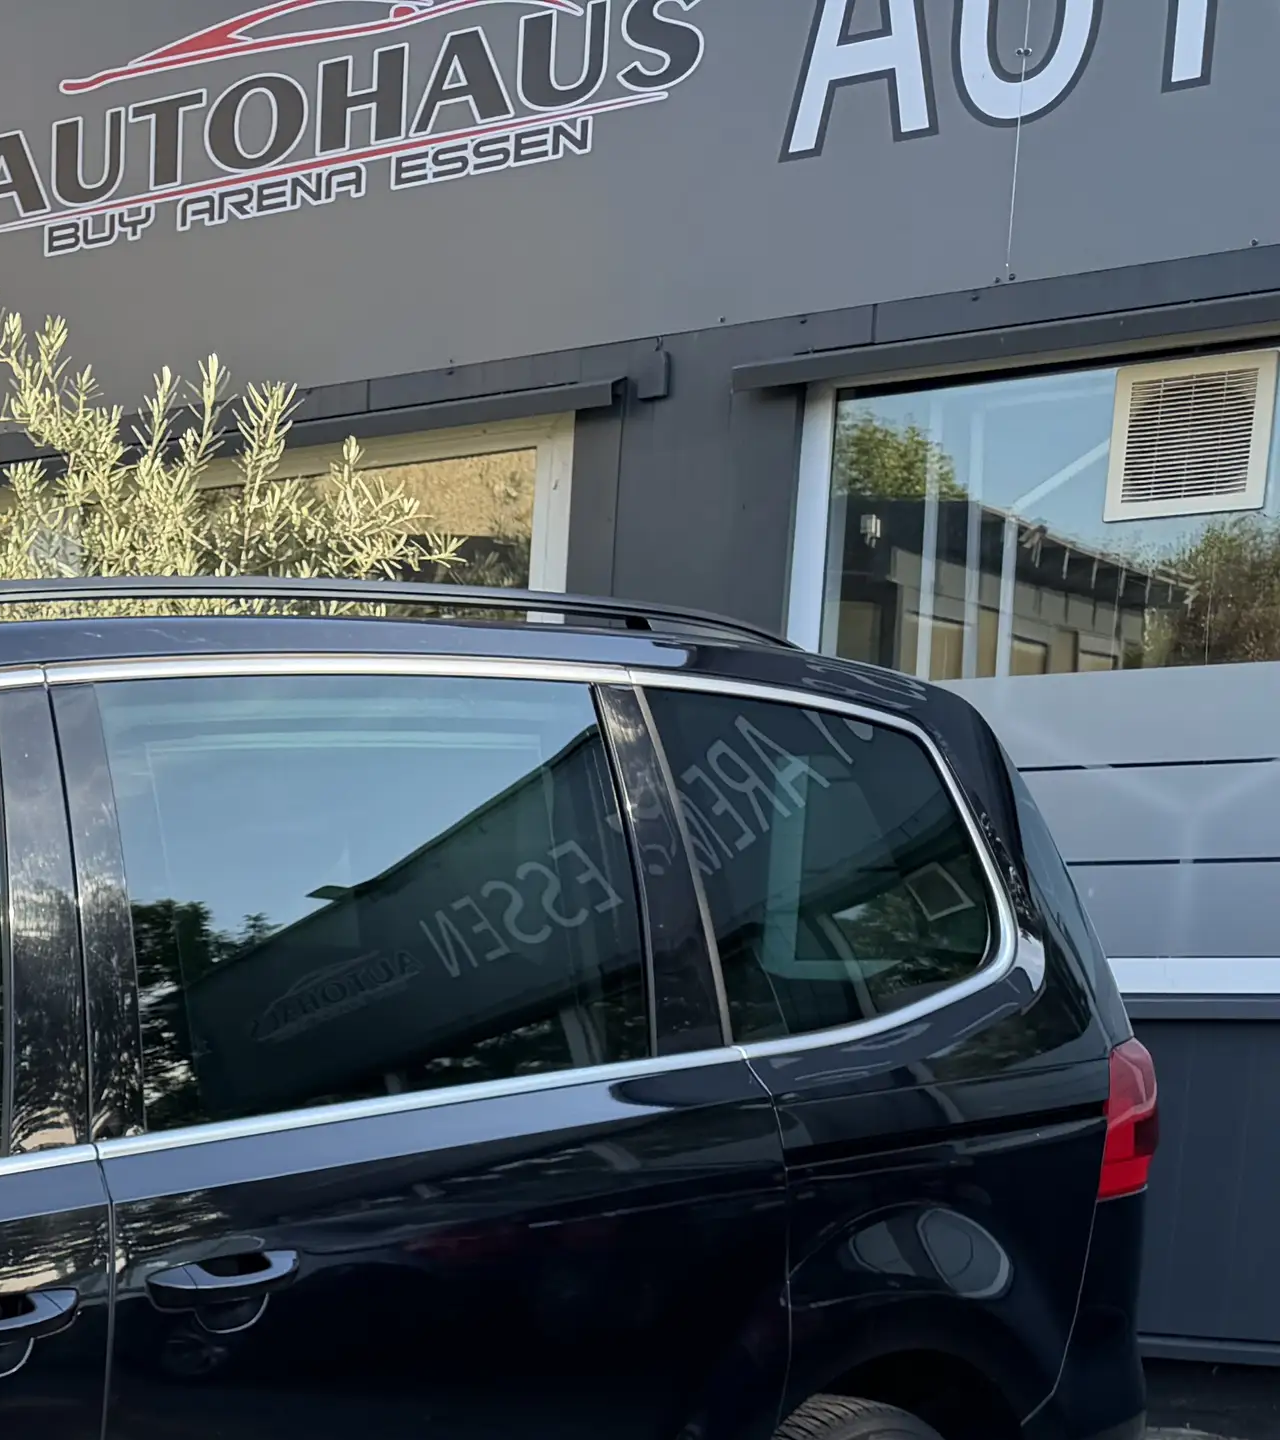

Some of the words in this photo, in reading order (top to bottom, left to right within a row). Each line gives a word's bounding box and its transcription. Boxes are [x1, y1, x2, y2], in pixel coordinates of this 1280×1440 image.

[44, 206, 154, 256] BUY
[179, 164, 365, 230] ARENA
[391, 116, 591, 190] ESSEN
